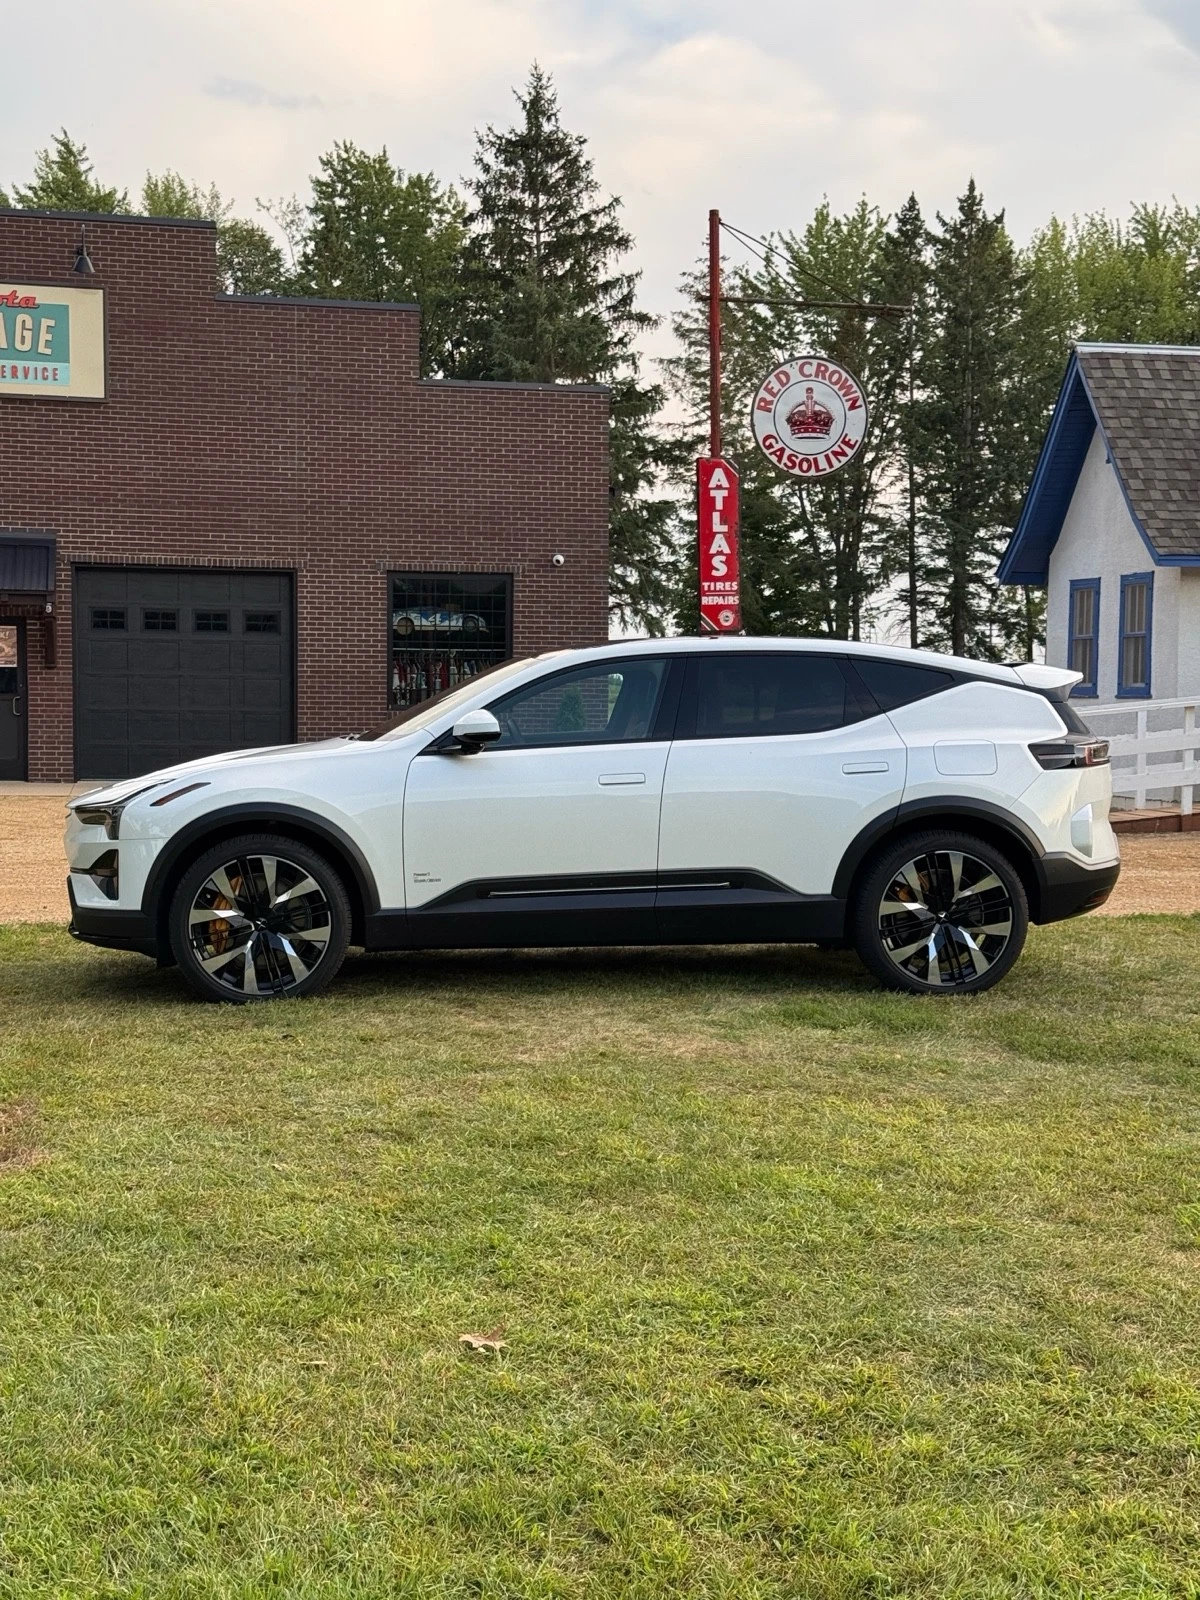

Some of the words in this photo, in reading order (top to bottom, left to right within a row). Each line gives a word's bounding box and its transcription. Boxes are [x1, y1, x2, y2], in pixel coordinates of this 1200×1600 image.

[0, 290, 40, 309] ta
[756, 369, 791, 413] RED
[798, 361, 862, 412] CROWN
[762, 433, 858, 473] GASOLINE
[708, 468, 731, 577] ATLAS
[702, 581, 738, 591] TIRES
[702, 596, 740, 605] REPAIRS
